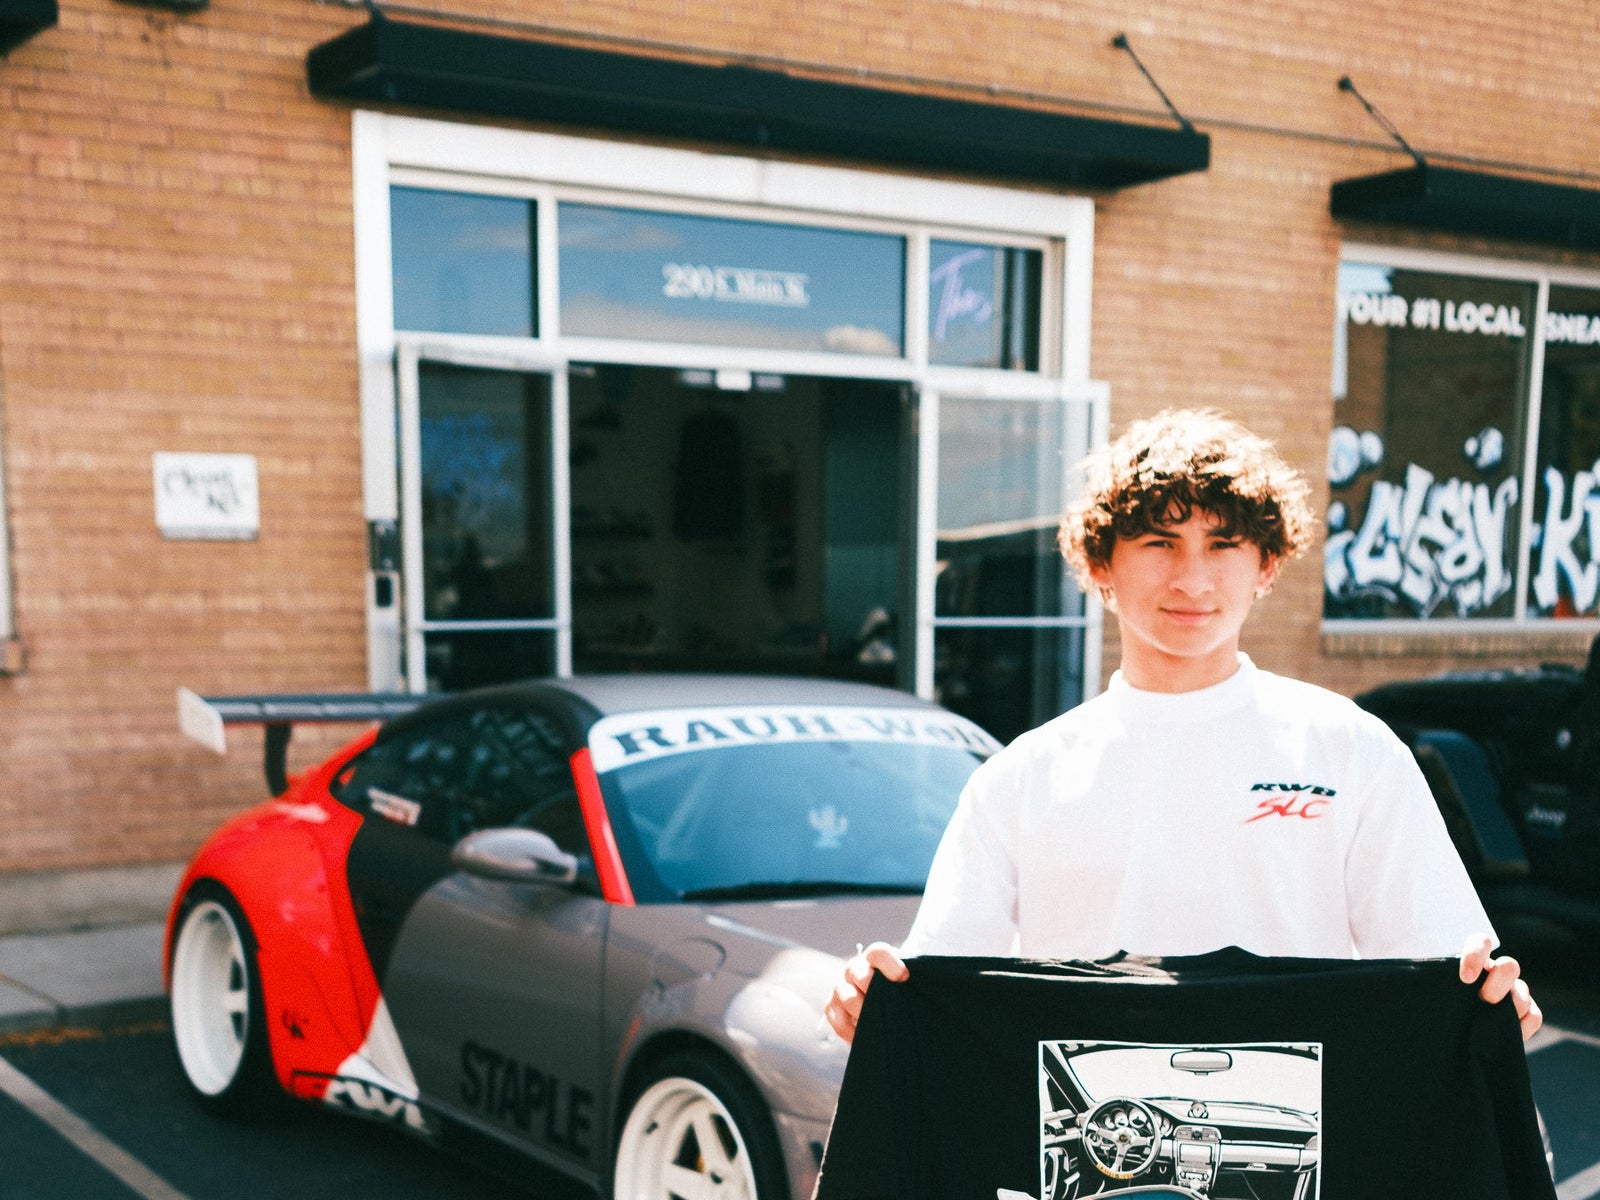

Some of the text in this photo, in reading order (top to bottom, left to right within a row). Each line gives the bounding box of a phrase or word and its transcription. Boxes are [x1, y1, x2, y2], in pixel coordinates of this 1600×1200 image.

[661, 262, 714, 299] 290
[1444, 302, 1527, 338] LOCAL
[1242, 791, 1329, 823] SLC
[1250, 783, 1337, 797] RWB
[459, 1039, 592, 1160] STAPLE
